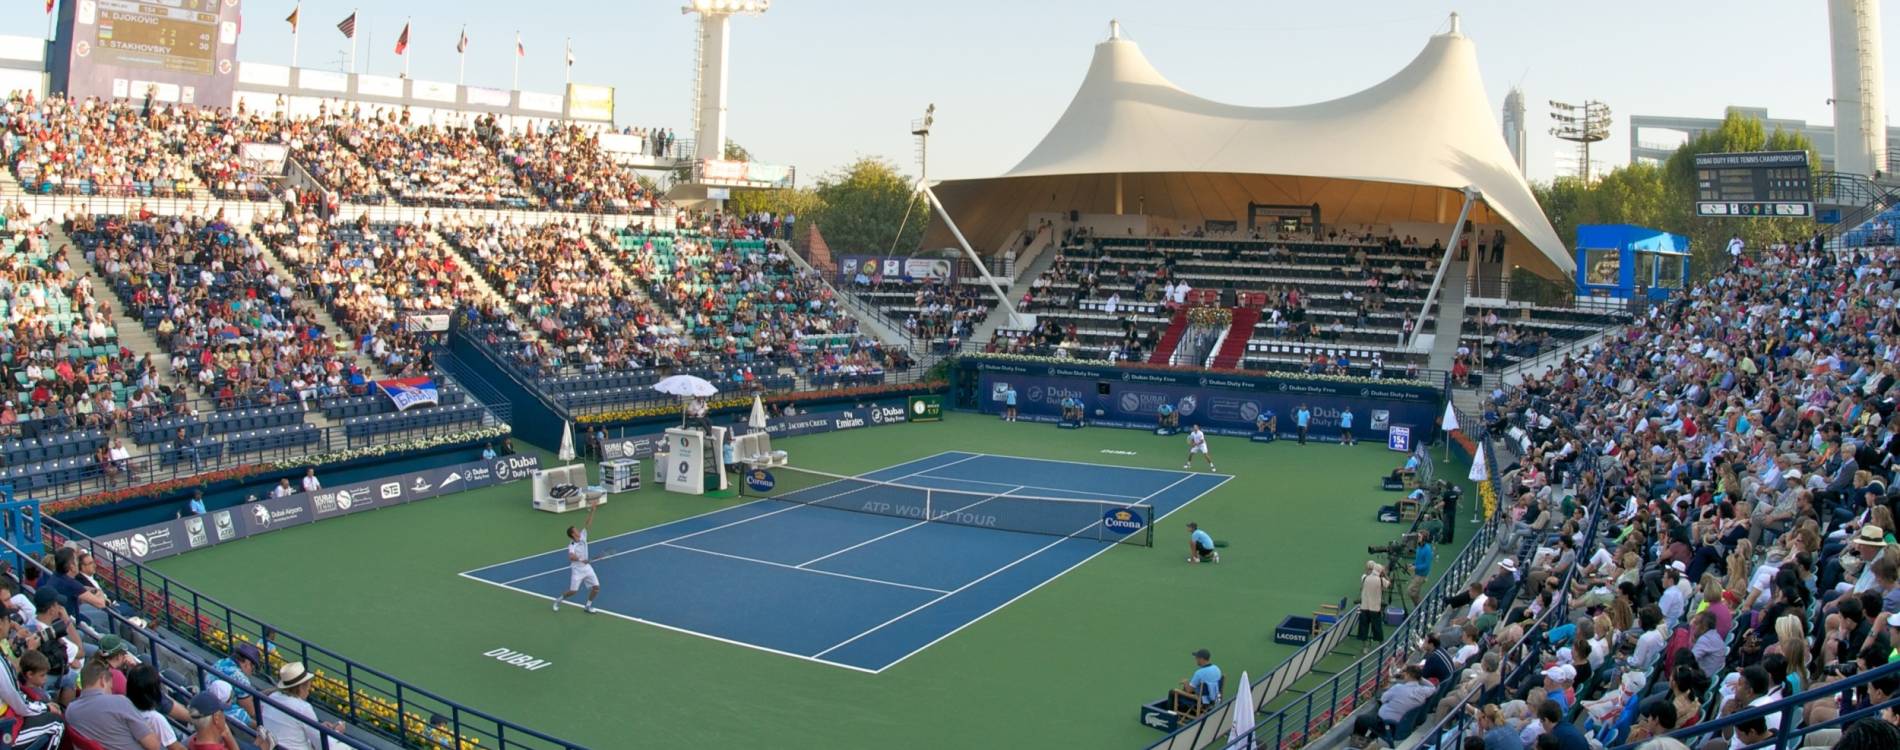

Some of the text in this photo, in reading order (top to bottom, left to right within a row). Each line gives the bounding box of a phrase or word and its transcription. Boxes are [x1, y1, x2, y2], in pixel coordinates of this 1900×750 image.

[112, 12, 159, 25] DJOKOVIC
[199, 33, 210, 41] 40
[110, 40, 171, 54] STAKHOVSKY
[199, 42, 209, 50] 30
[1696, 157, 1712, 165] DUBAI
[1727, 156, 1739, 164] FREE
[1740, 155, 1759, 164] TENNIS
[1759, 154, 1805, 163] CHAMPIONSHIPS
[1048, 386, 1082, 399] Dubai
[1390, 391, 1404, 399] Duty
[844, 411, 853, 419] Fly
[882, 407, 904, 417] Dubai
[1313, 406, 1340, 418] Dub
[809, 419, 828, 427] CREEK
[836, 418, 864, 429] Emirates
[884, 416, 895, 424] Duty
[1312, 417, 1332, 427] Duty
[1393, 435, 1405, 444] 154
[604, 442, 622, 452] DUBAI
[509, 456, 537, 470] Dubai
[472, 467, 489, 476] Dubai
[512, 469, 526, 479] Duty
[746, 475, 773, 487] Corona
[313, 493, 336, 505] DUBAI
[271, 510, 286, 518] Dubai
[285, 506, 303, 517] Airports
[862, 500, 890, 513] ATP
[955, 511, 997, 527] TOUR
[1105, 517, 1141, 528] Corona
[220, 529, 233, 537] ATP
[103, 536, 129, 549] DUBAI
[192, 535, 206, 544] ATP
[1276, 632, 1306, 642] LACOSTE
[483, 647, 552, 671] DUBAI
